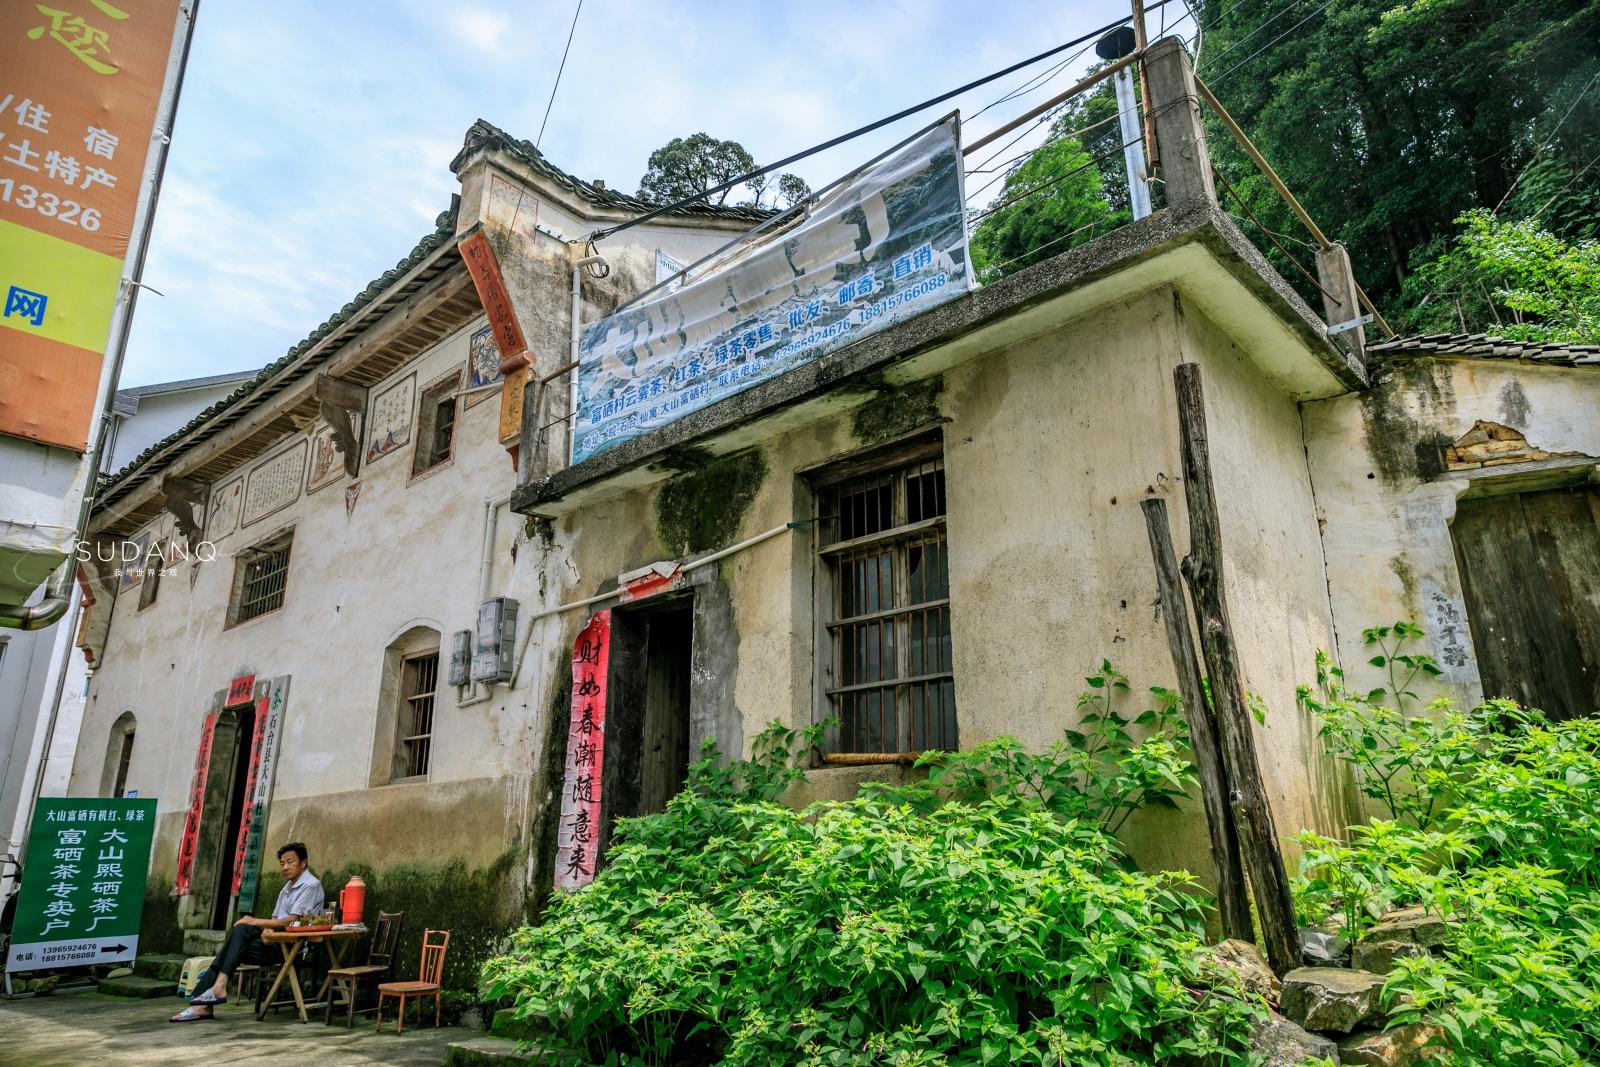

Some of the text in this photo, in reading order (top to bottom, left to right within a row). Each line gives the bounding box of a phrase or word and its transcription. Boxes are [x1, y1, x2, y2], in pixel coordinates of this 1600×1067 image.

[4, 285, 48, 326] 网
[858, 273, 946, 323] 18815766088
[46, 810, 145, 821] 大山富硒有机红、绿茶
[39, 828, 87, 936] 富硒茶专卖户
[41, 951, 96, 962] 18815766088
[42, 943, 97, 953] 13965924676
